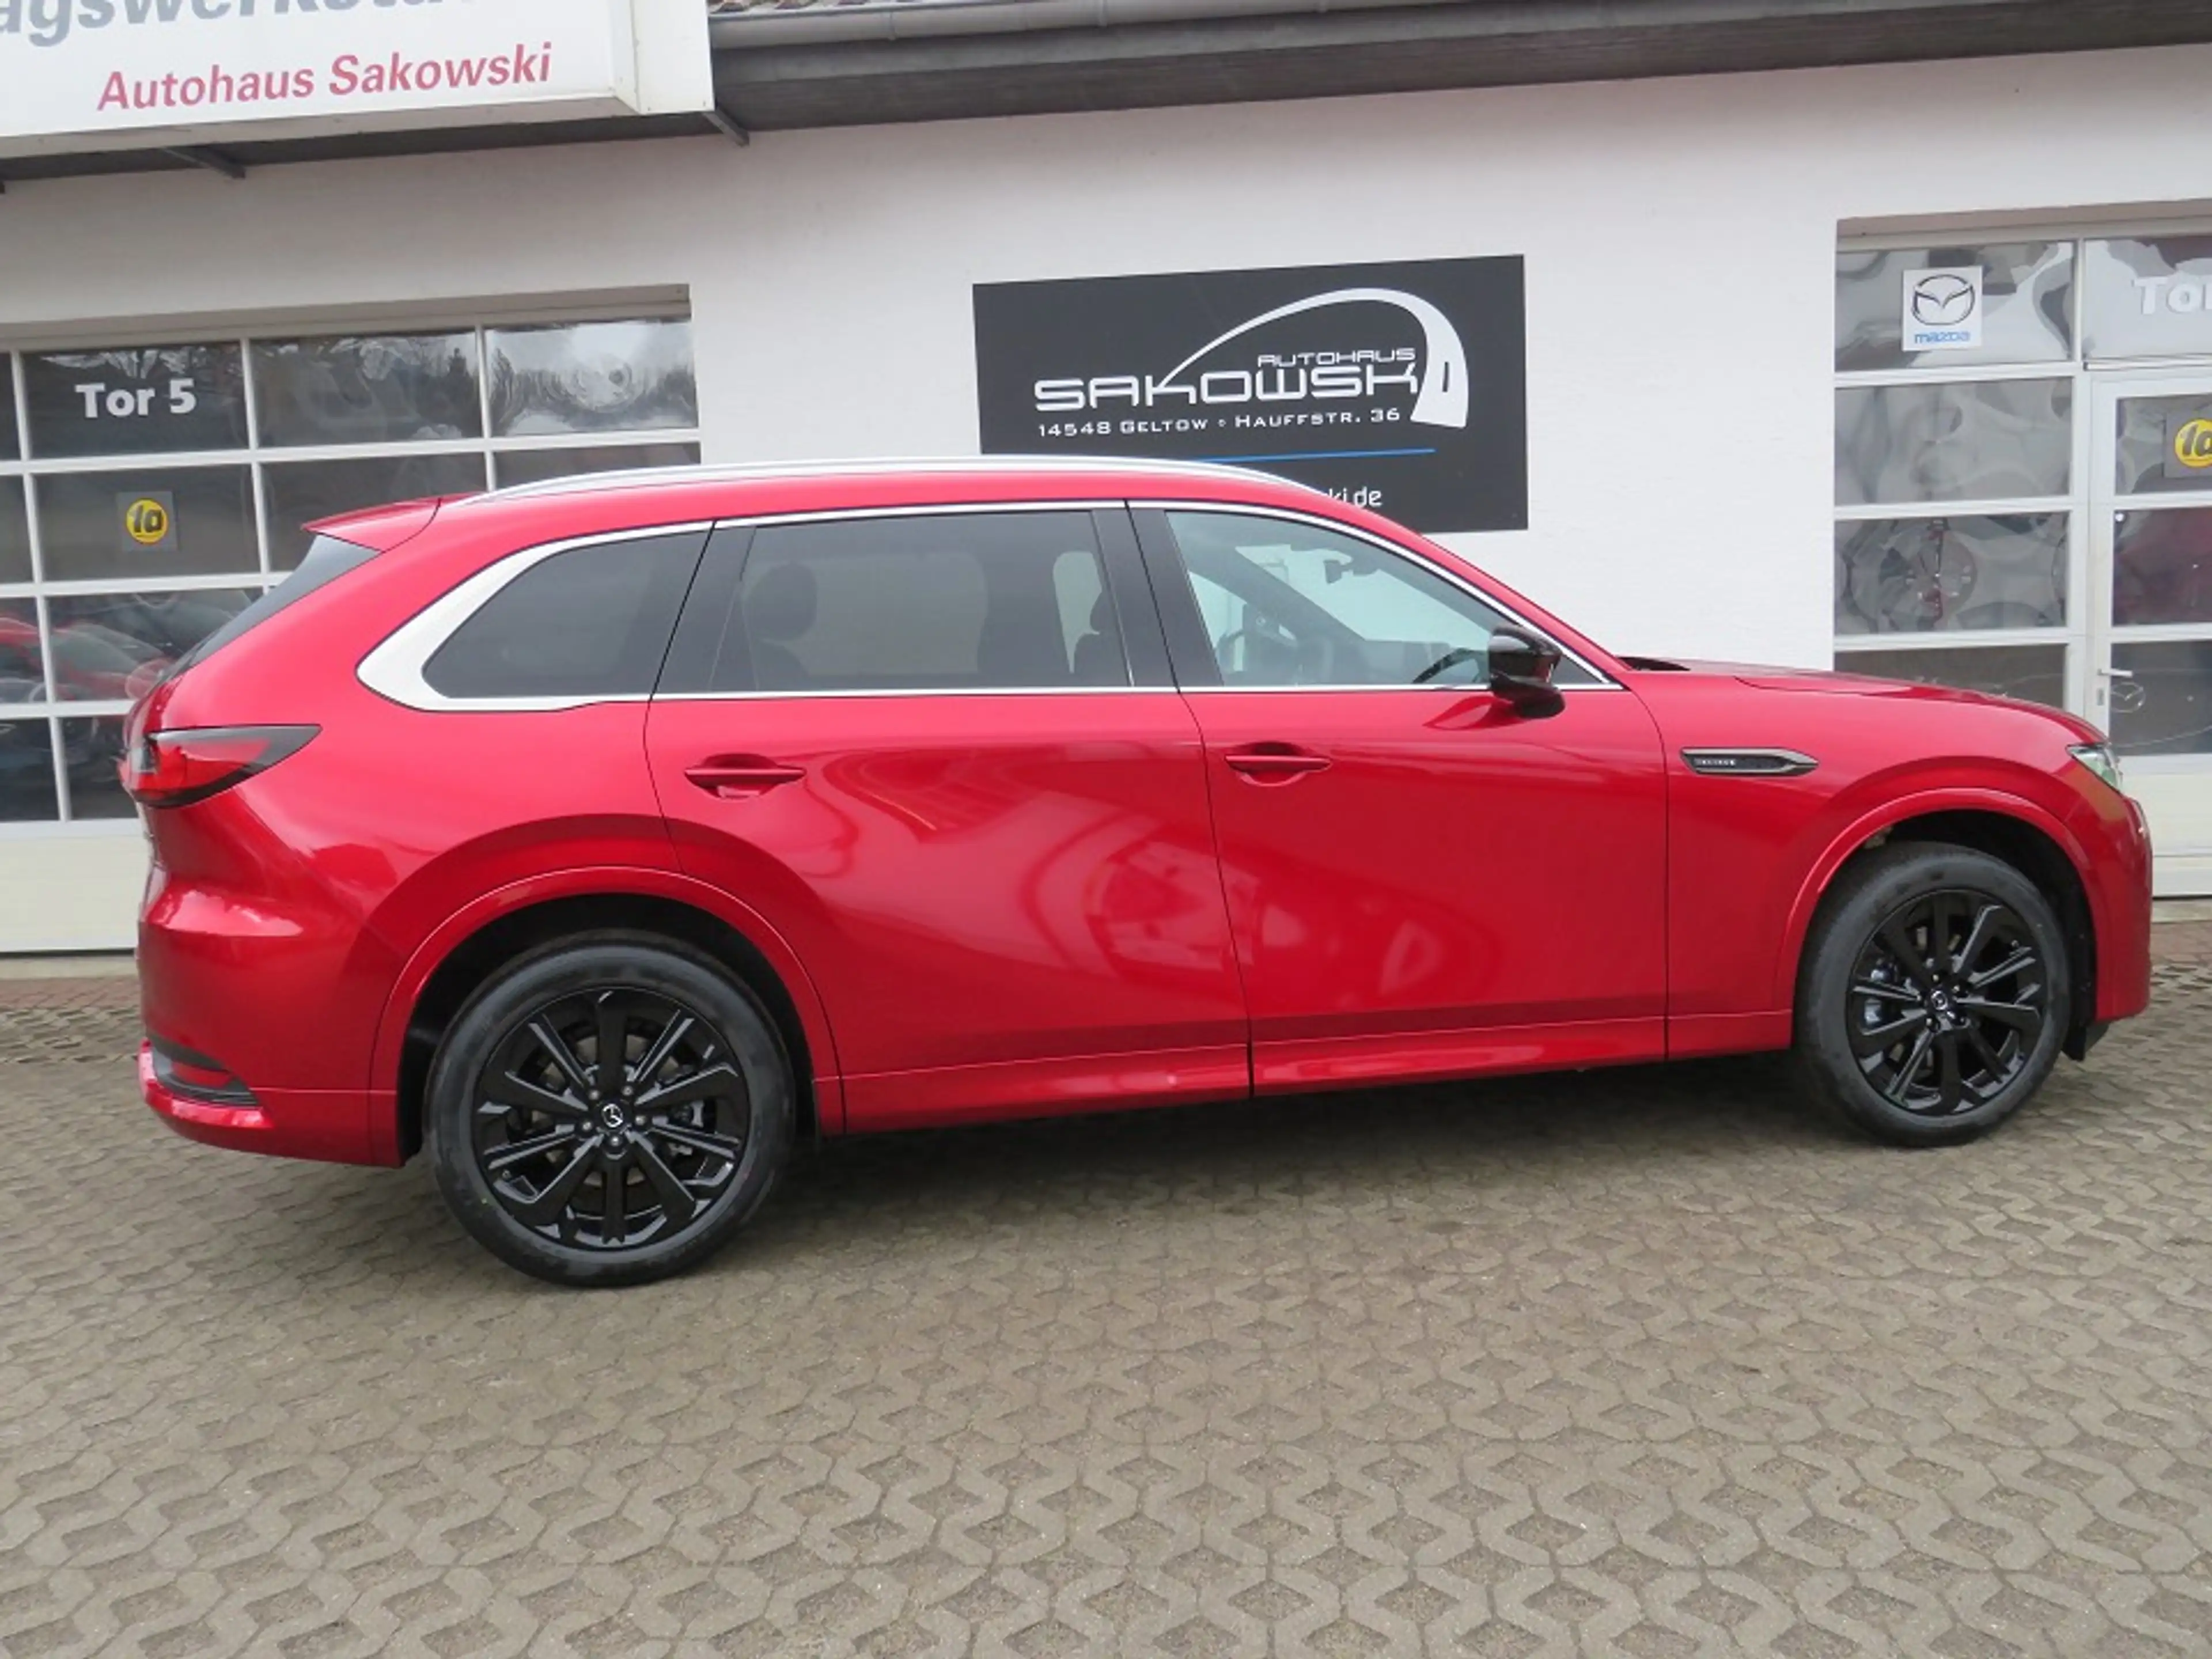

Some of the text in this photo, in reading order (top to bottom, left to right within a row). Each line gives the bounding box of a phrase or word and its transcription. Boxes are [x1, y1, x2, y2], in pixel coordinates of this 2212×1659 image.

[97, 41, 552, 111] Autohaus Sakowski
[1257, 347, 1416, 368] AUTOHAUS
[75, 378, 197, 418] Tor 5
[1039, 408, 1400, 437] 14548 GELTOW HAUFFSTR. 36
